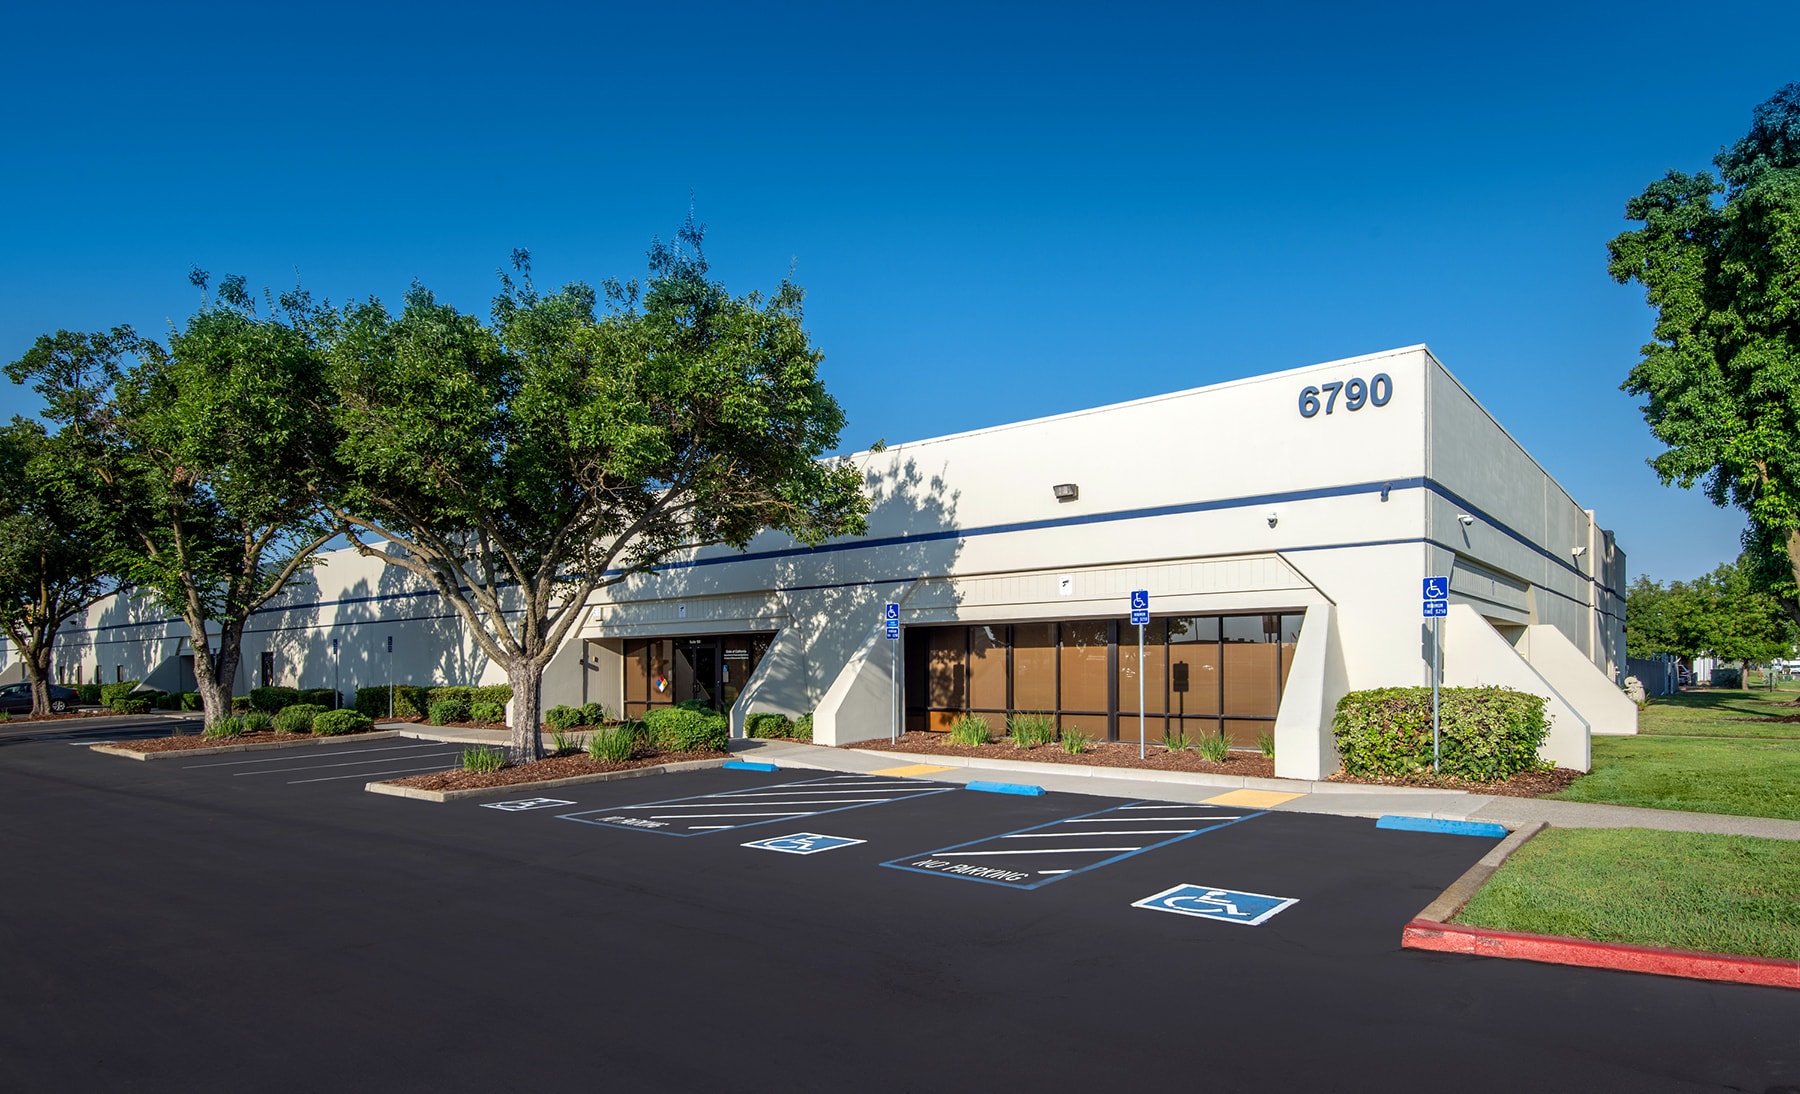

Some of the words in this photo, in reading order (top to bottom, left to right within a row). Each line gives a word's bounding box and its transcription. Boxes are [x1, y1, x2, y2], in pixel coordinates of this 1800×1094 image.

[1298, 372, 1393, 418] 6790
[911, 859, 950, 868] NO
[941, 864, 1029, 881] PARKING
